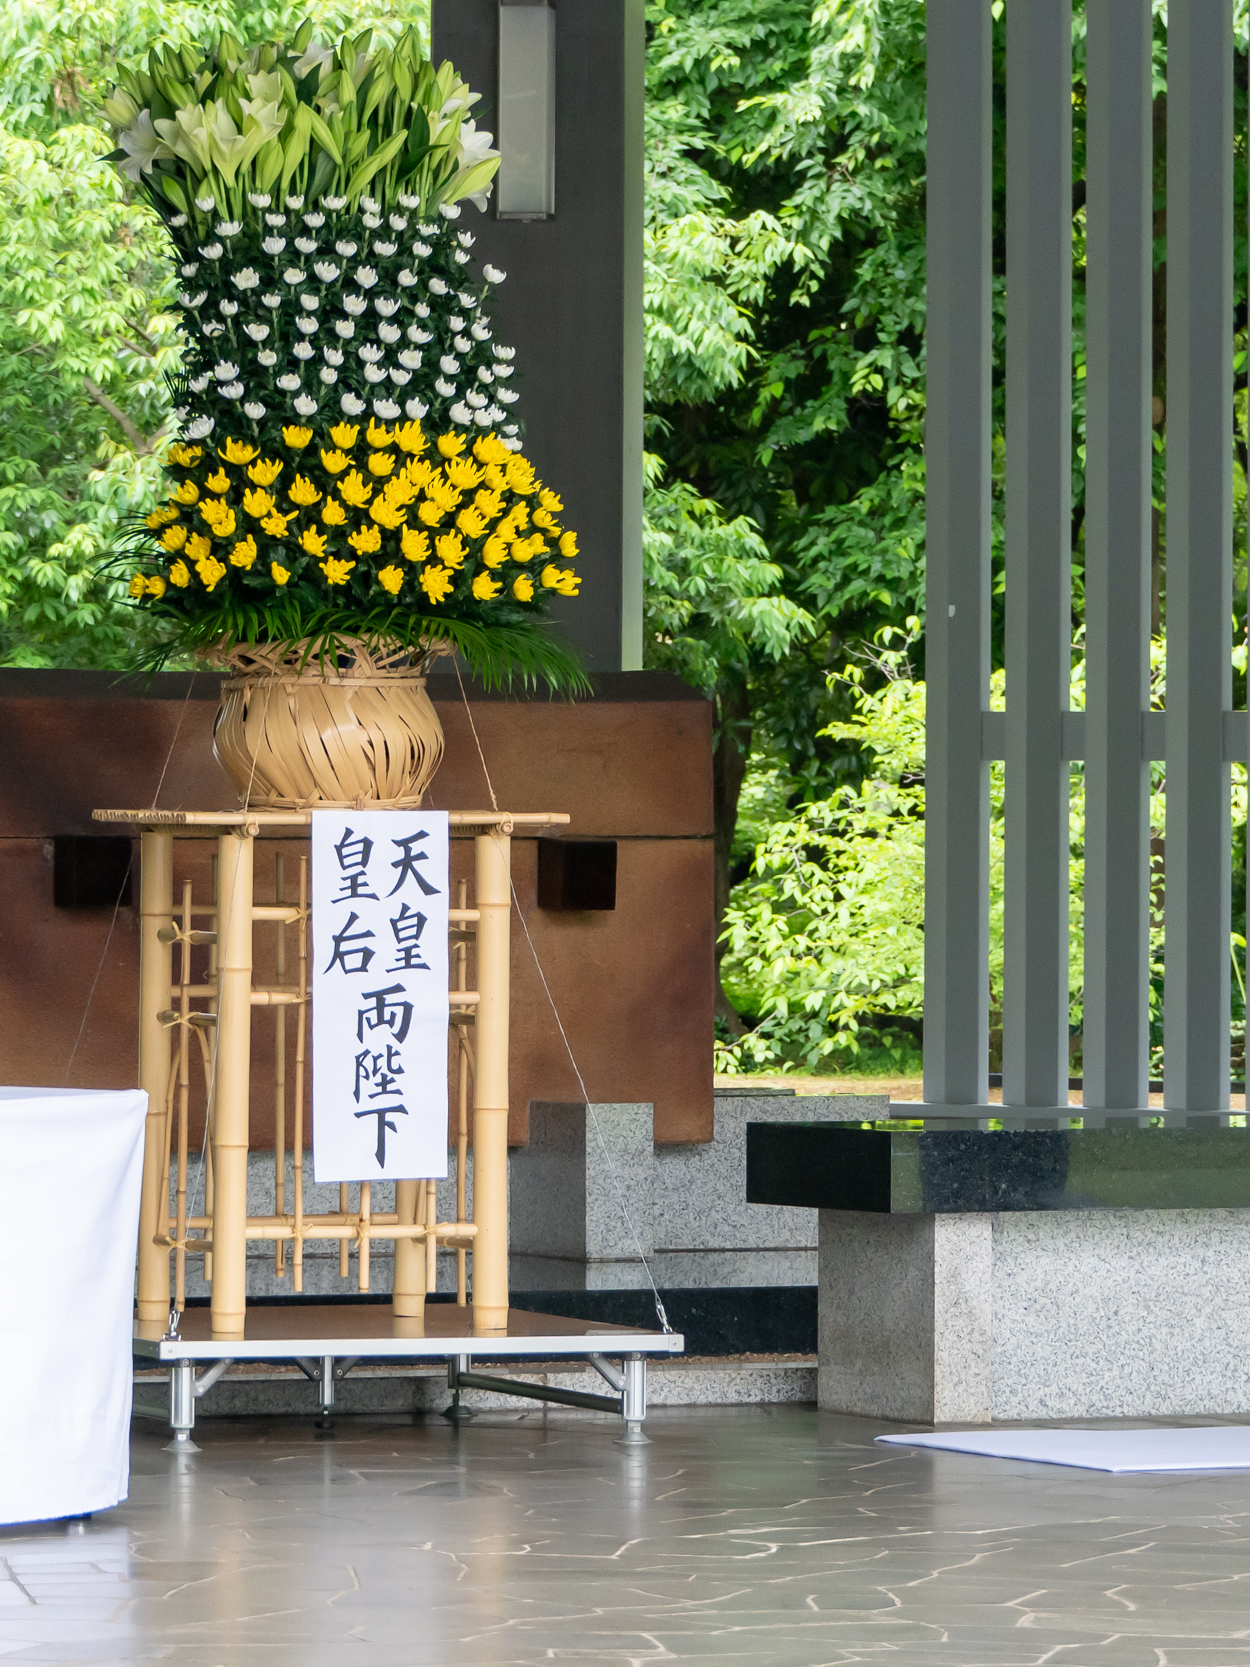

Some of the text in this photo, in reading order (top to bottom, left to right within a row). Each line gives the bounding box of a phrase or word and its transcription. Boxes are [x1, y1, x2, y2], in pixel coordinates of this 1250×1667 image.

[322, 826, 380, 975] 皇后
[385, 830, 442, 974] 天皇
[352, 982, 415, 1169] 両陛下
